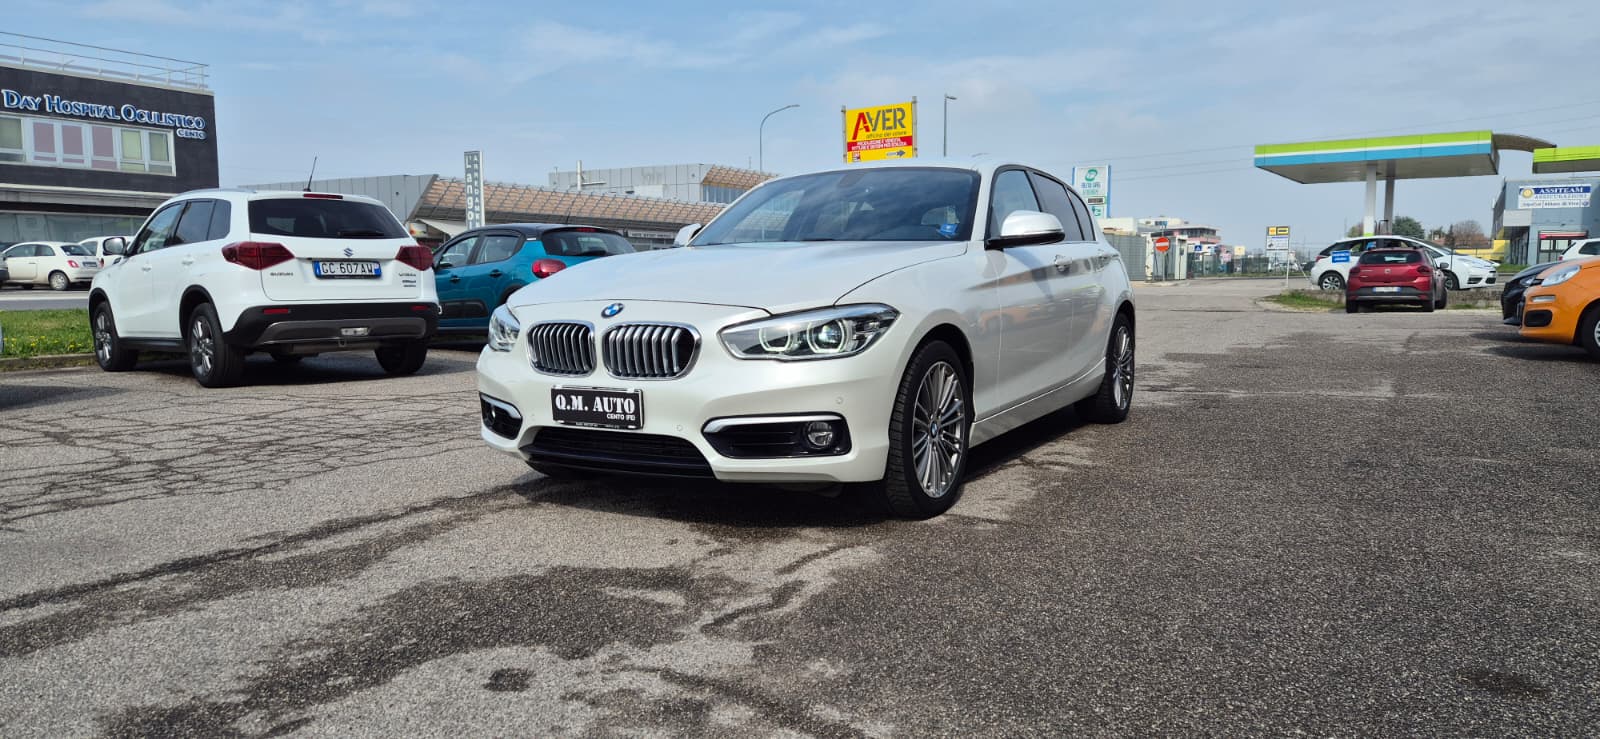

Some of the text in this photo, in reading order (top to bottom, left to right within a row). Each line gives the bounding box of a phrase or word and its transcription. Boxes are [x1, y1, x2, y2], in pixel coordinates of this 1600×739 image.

[852, 107, 906, 140] AVER
[555, 394, 636, 414] Q.M. AUTO
